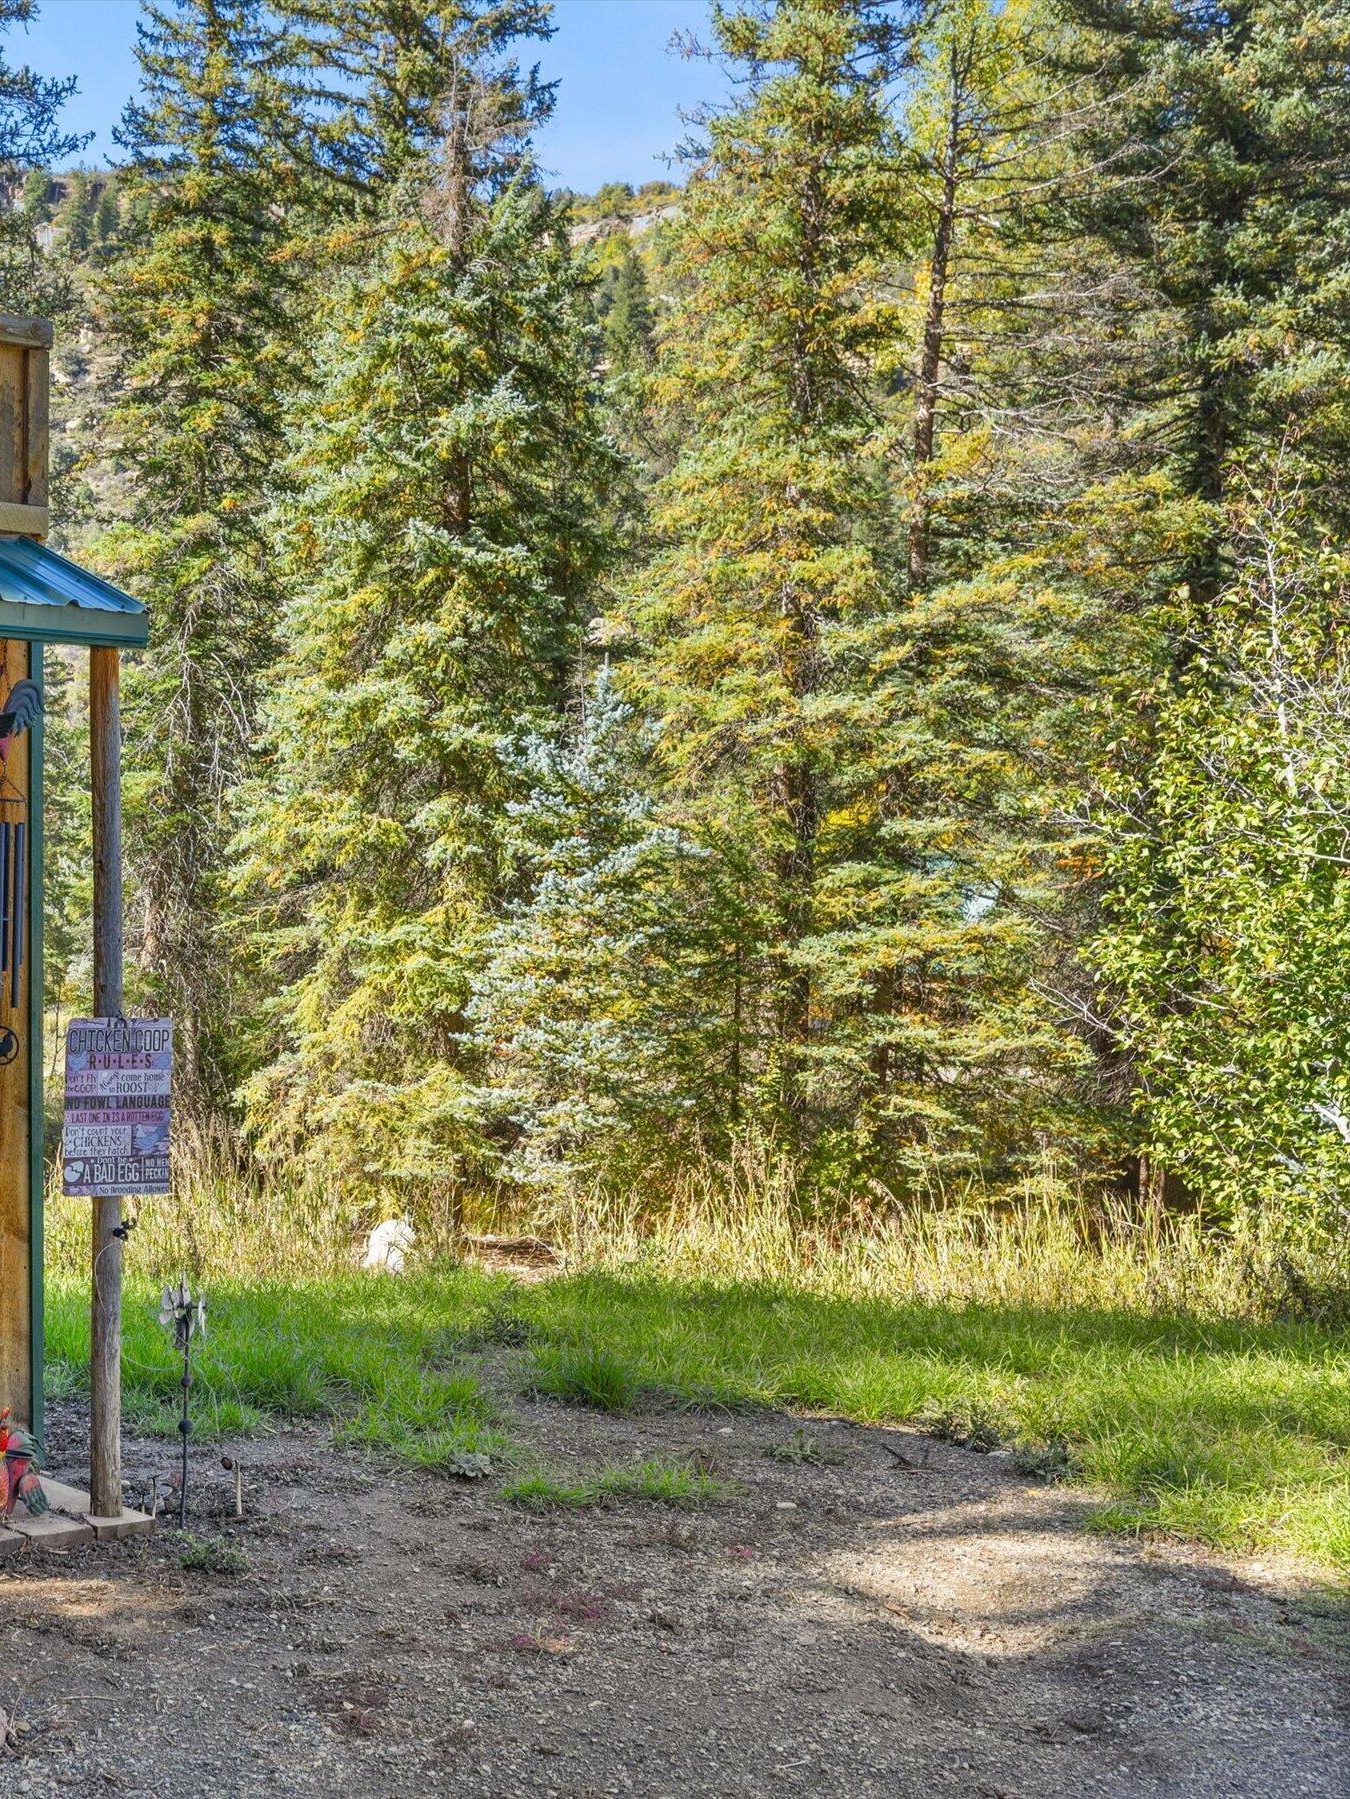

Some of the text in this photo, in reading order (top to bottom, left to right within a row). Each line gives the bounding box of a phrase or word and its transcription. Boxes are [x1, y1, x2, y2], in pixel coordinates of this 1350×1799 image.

[69, 1029, 170, 1053] CHICKEN COOP
[121, 1073, 142, 1082] come
[143, 1072, 165, 1082] home
[74, 1084, 97, 1094] COOP
[116, 1081, 149, 1093] ROOST
[65, 1095, 170, 1110] NO FOWL LANGUAGE
[71, 1110, 164, 1124] LAST ONE IN IS A ROTTEN EGG
[87, 1127, 108, 1136] count
[73, 1136, 122, 1147] CHICKENS
[65, 1147, 88, 1156] before
[117, 1156, 127, 1164] be
[145, 1158, 155, 1167] NO
[83, 1162, 140, 1184] A BAD EGG
[99, 1186, 109, 1194] No
[110, 1185, 142, 1195] Brooding
